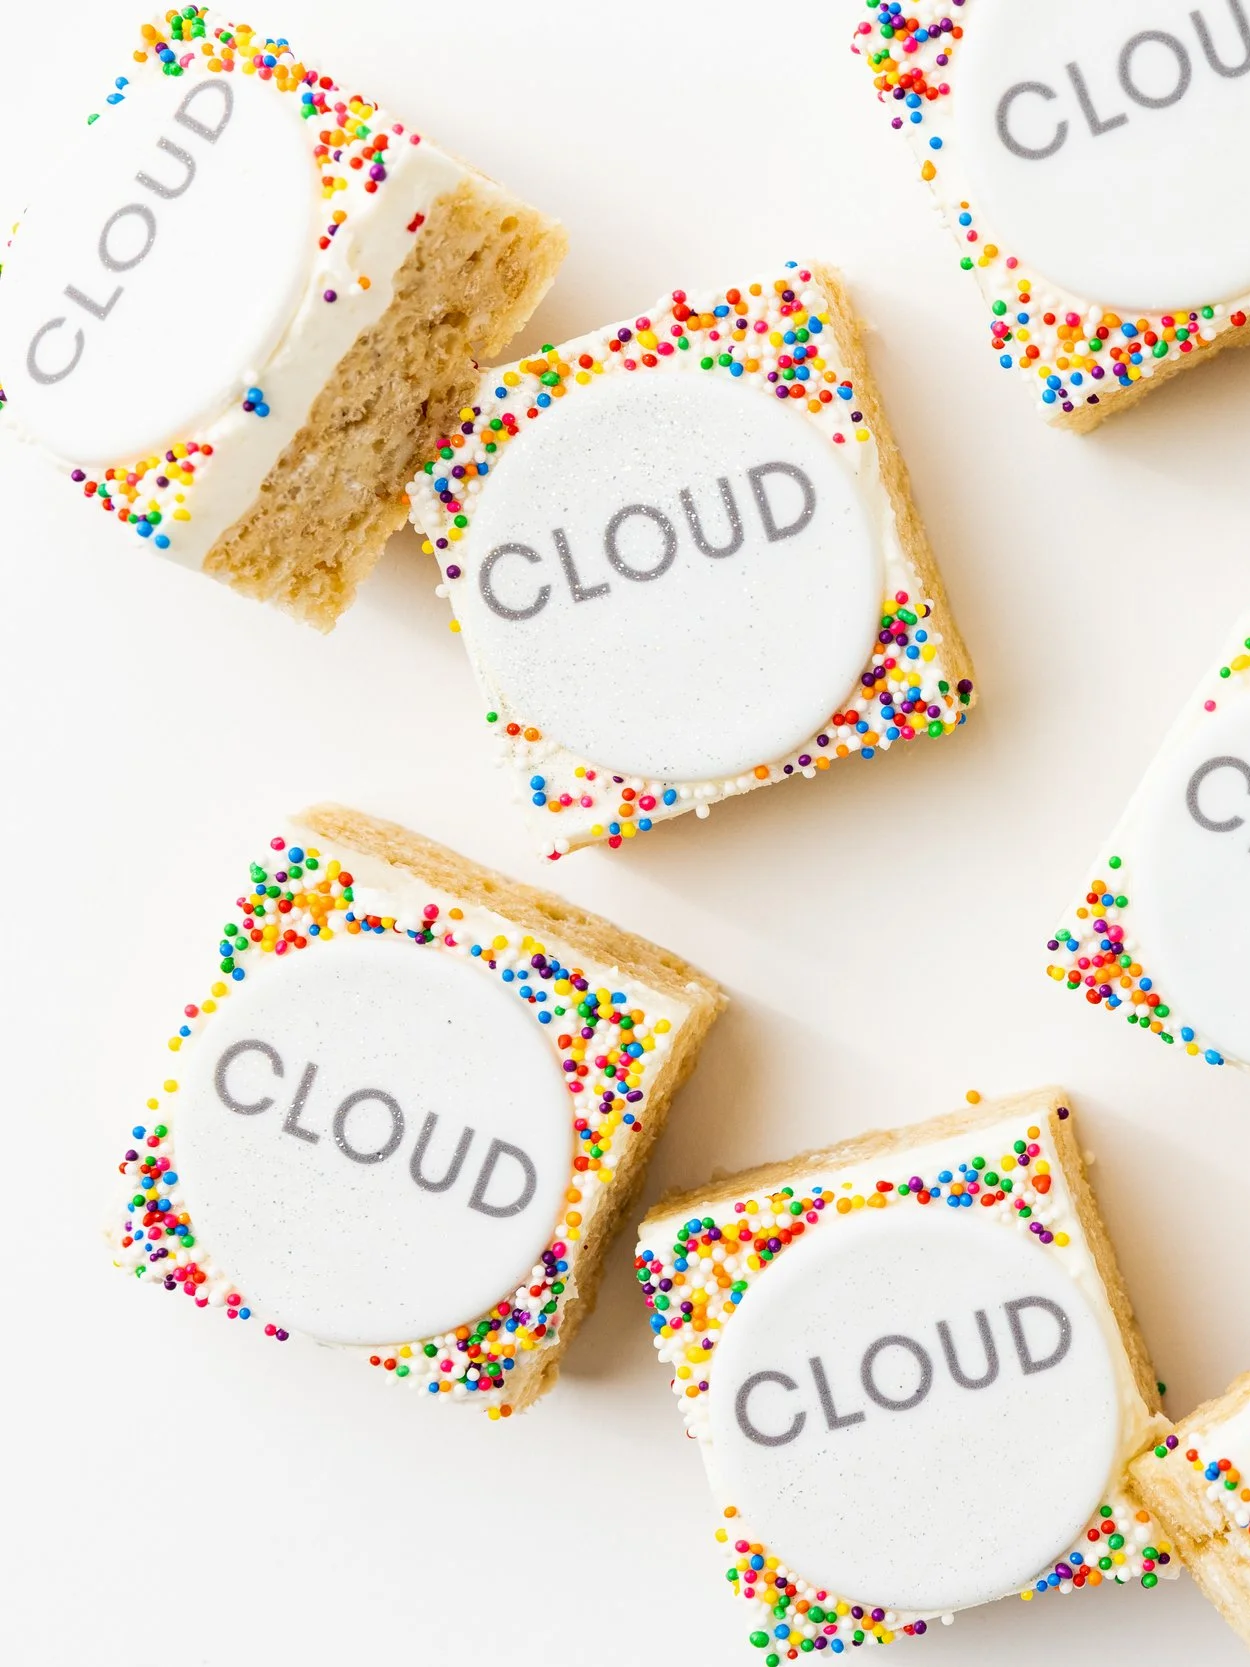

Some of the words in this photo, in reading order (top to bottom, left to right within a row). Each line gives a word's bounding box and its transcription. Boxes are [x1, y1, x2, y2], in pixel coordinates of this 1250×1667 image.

[26, 79, 234, 385] CLOUD
[478, 460, 817, 623] CLOUD
[213, 1039, 538, 1219] CLOUD
[734, 1295, 1073, 1448] CLOUD
